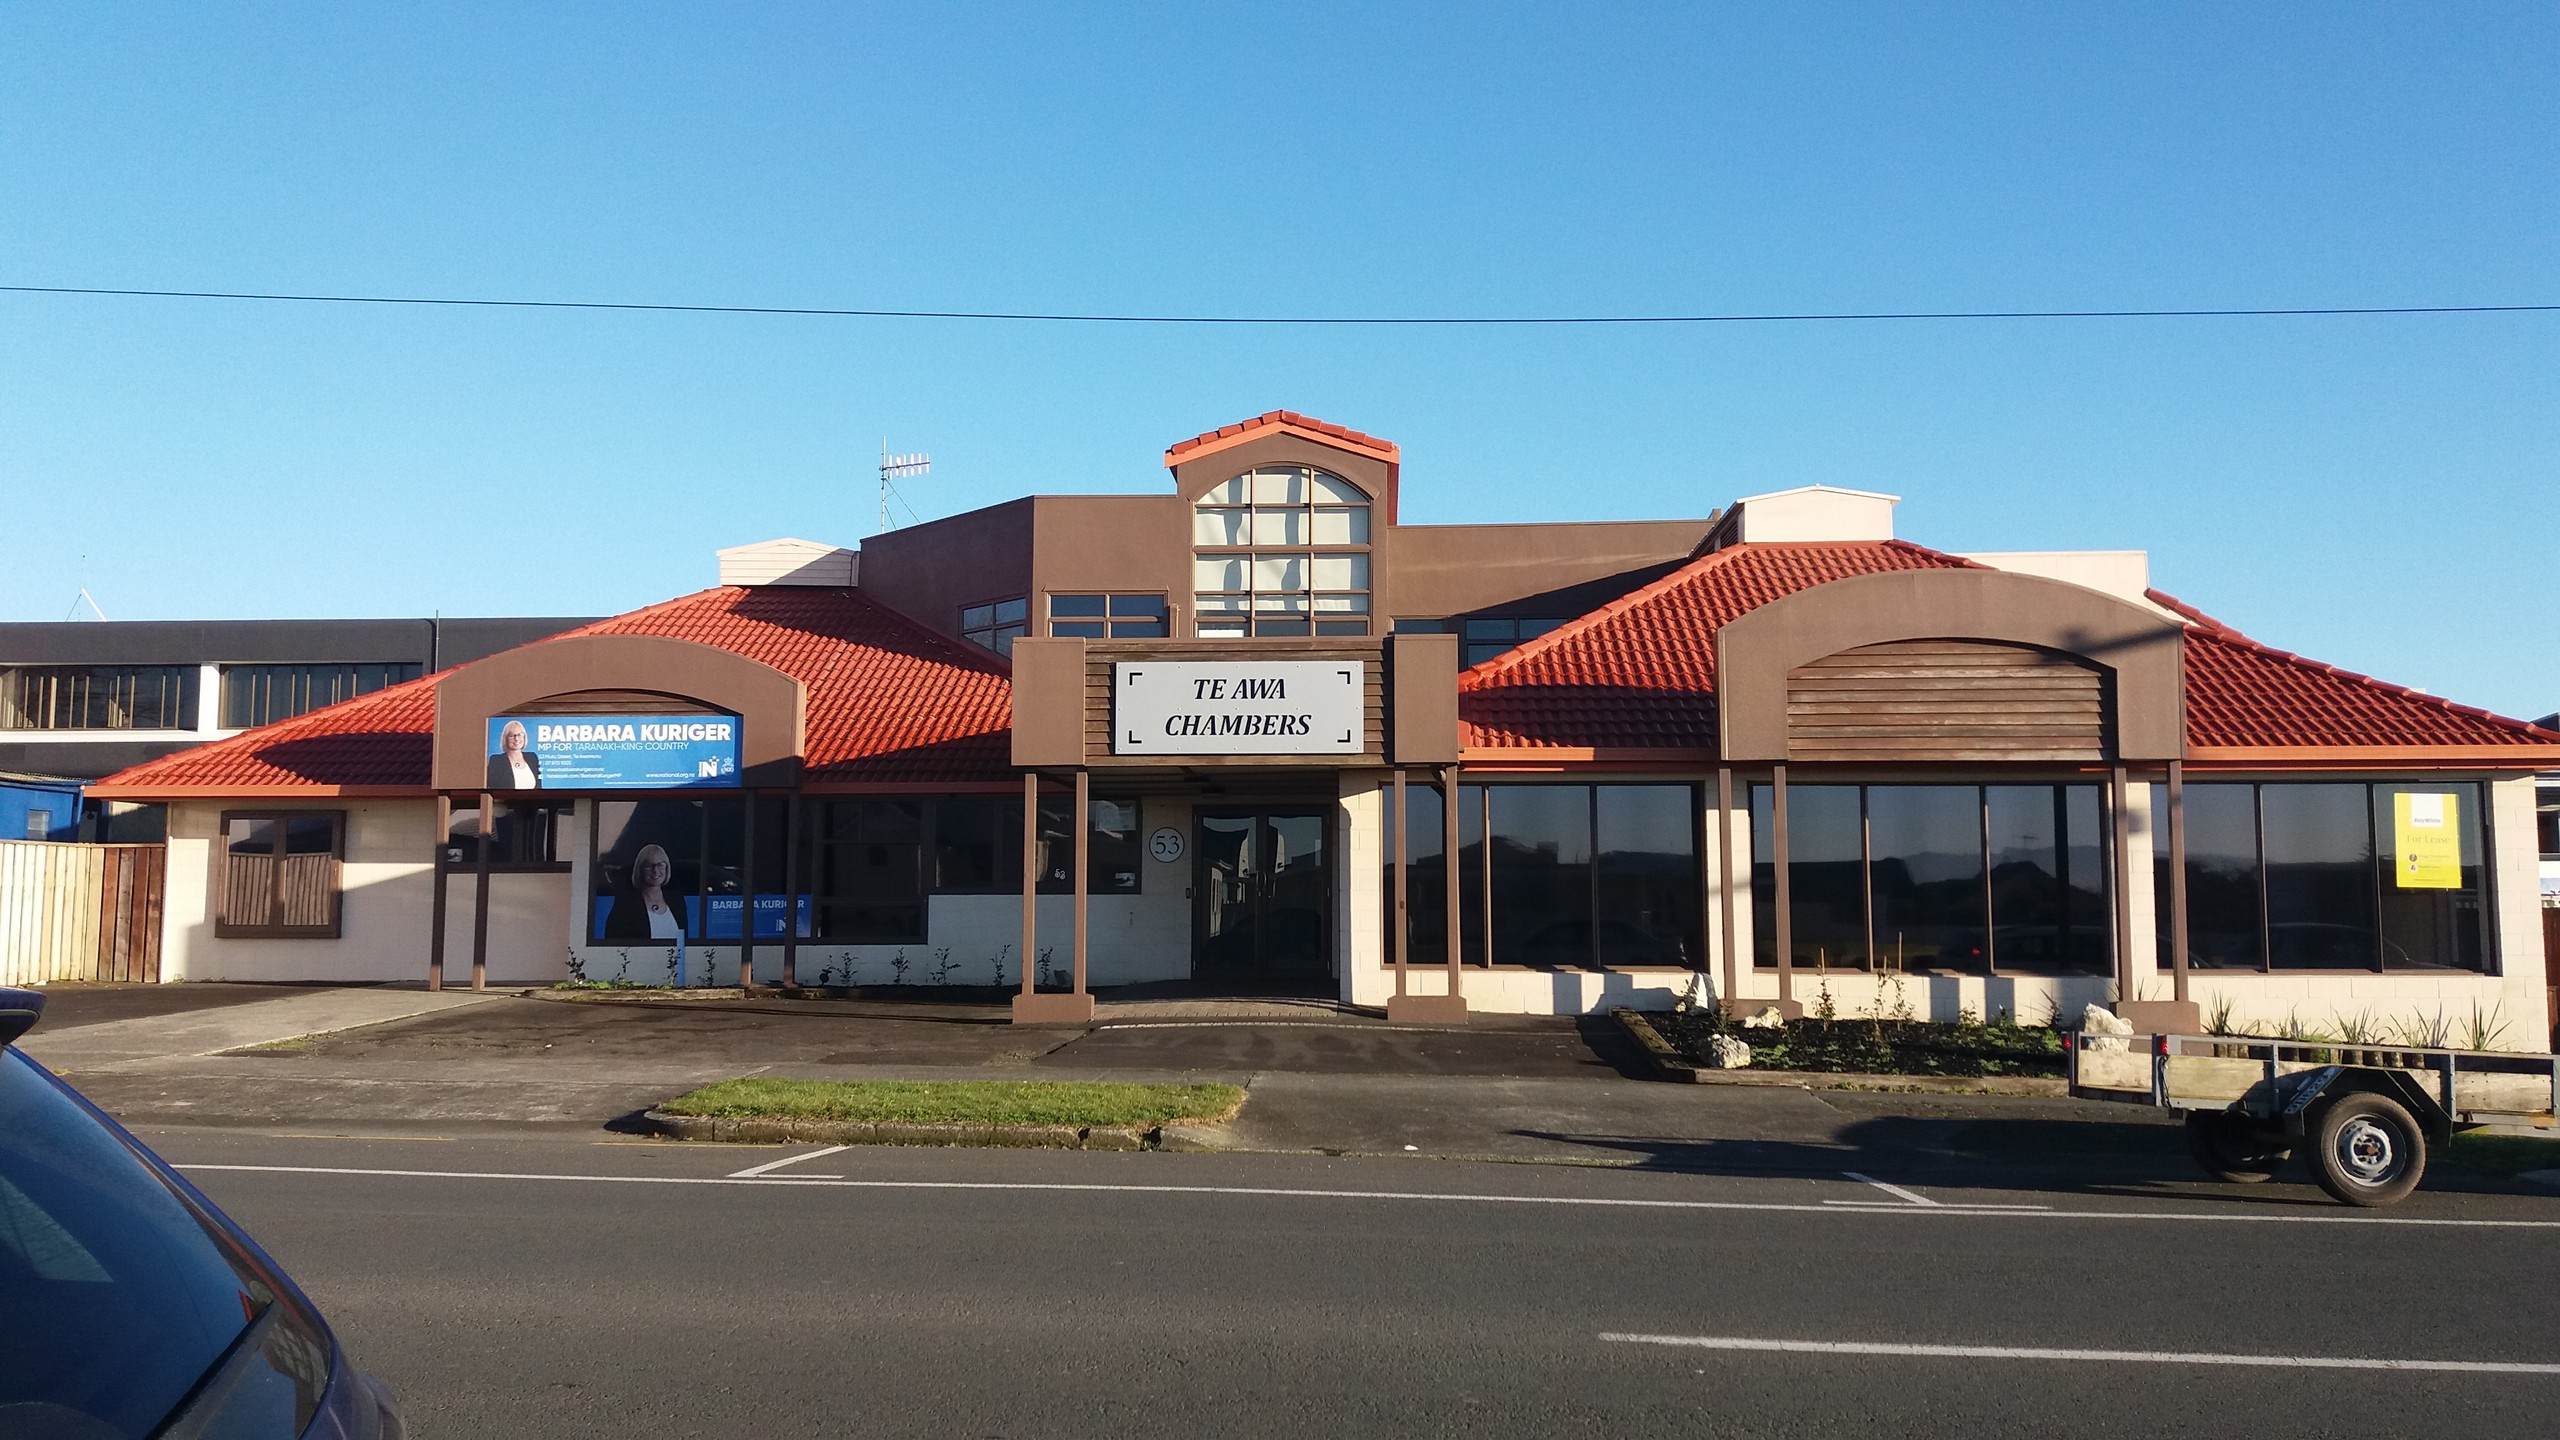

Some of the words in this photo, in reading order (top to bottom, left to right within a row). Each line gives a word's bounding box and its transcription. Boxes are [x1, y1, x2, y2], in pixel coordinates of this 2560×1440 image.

[1194, 679, 1227, 699] TE
[1231, 679, 1286, 699] AWA
[538, 724, 636, 742] BARBARA
[640, 723, 731, 741] KURIGER
[1165, 714, 1312, 736] CHAMBERS
[538, 743, 552, 751] MP
[553, 743, 572, 751] FOR
[574, 742, 643, 751] TARANAKI-KING
[645, 741, 690, 751] COUNTRY
[1155, 835, 1180, 855] 53
[2407, 835, 2421, 843] For
[2425, 835, 2450, 843] Lease
[712, 900, 759, 909] BARBAA
